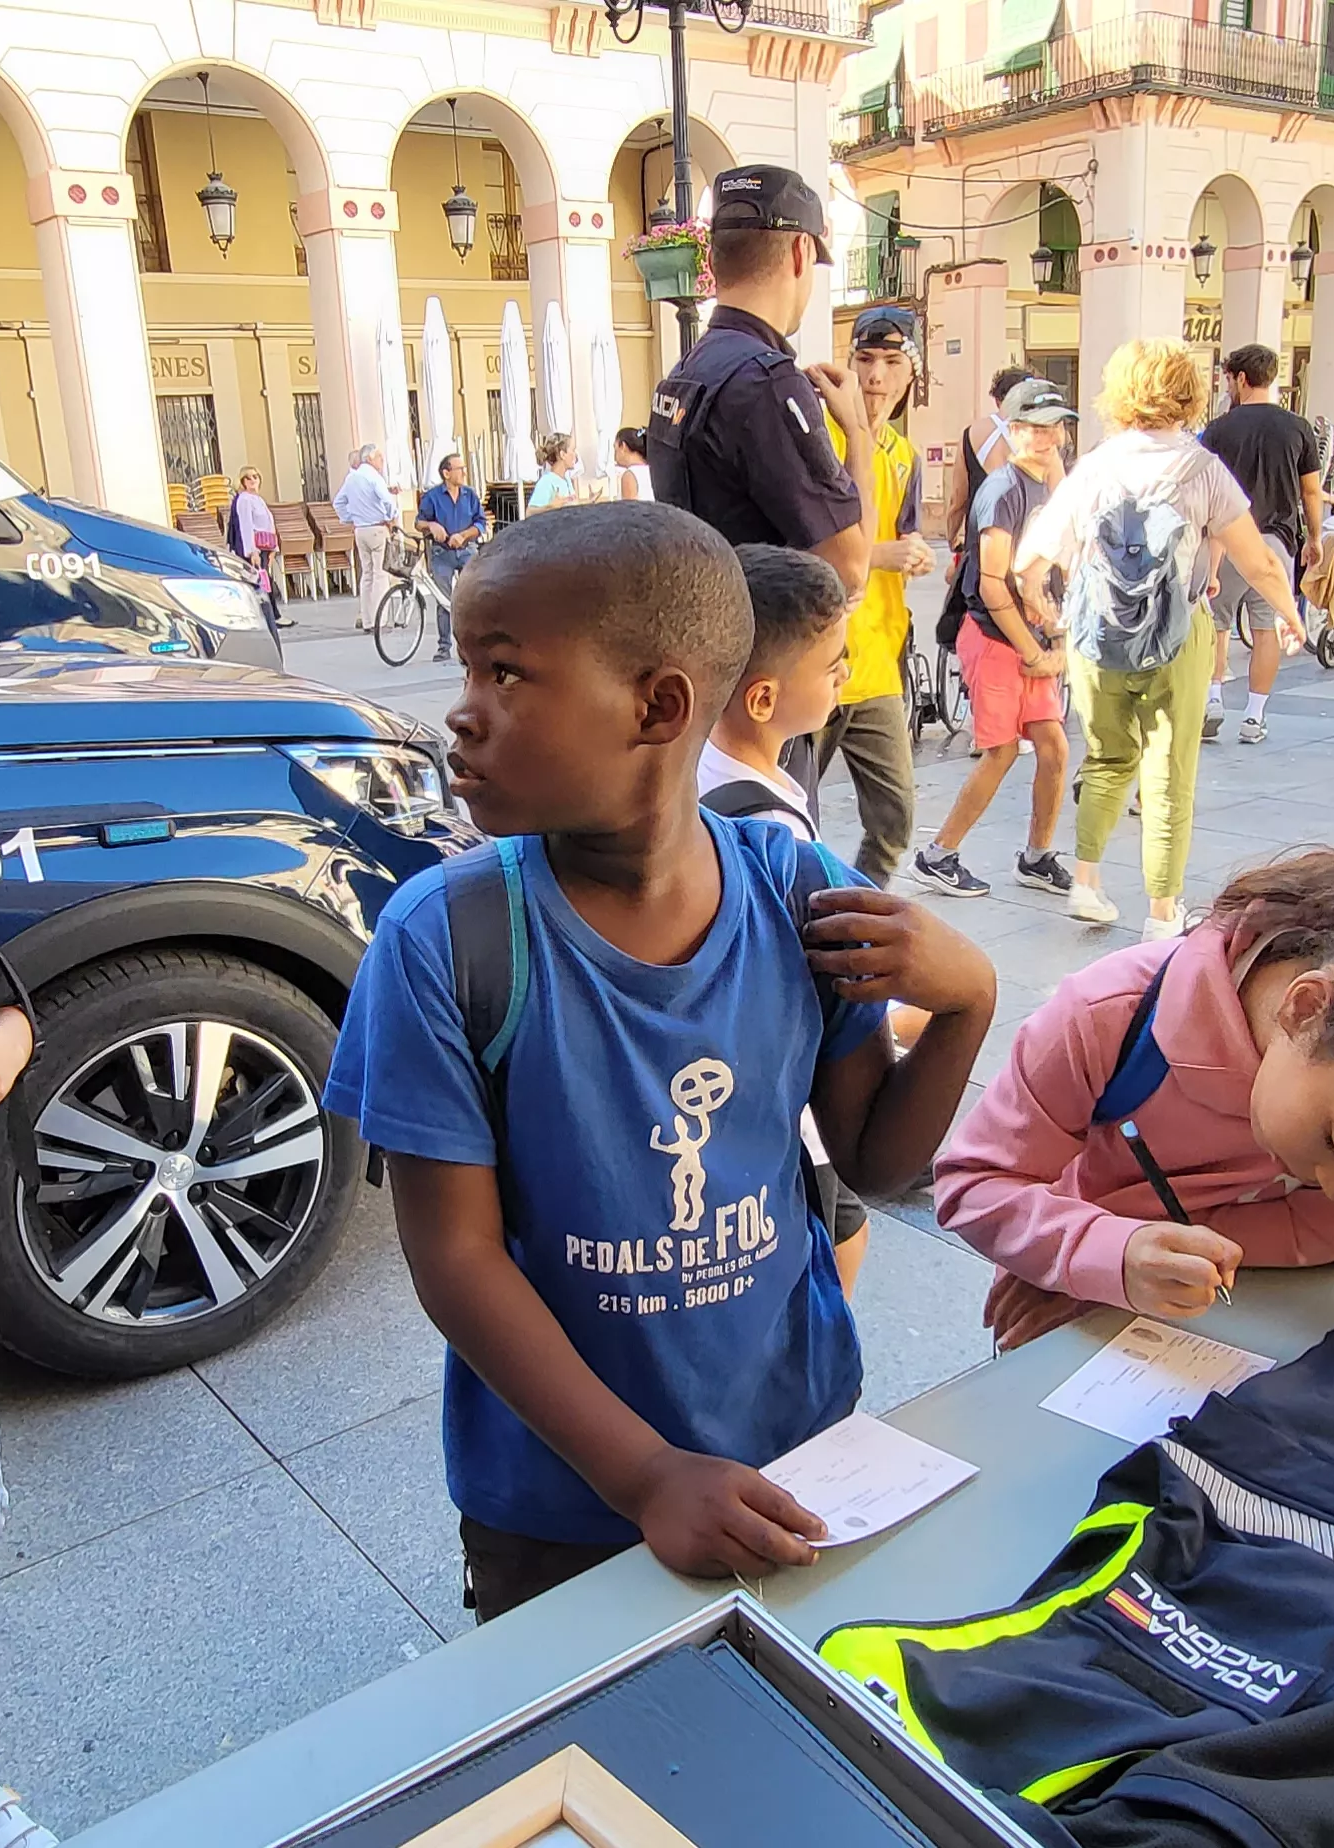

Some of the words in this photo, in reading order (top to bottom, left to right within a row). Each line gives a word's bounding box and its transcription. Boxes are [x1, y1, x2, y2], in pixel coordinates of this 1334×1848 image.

[565, 1233, 675, 1275] PEDALS
[681, 1236, 710, 1269] DE
[597, 1293, 632, 1315] 215
[638, 1293, 667, 1315] km
[1130, 1570, 1299, 1687] NACIONAL
